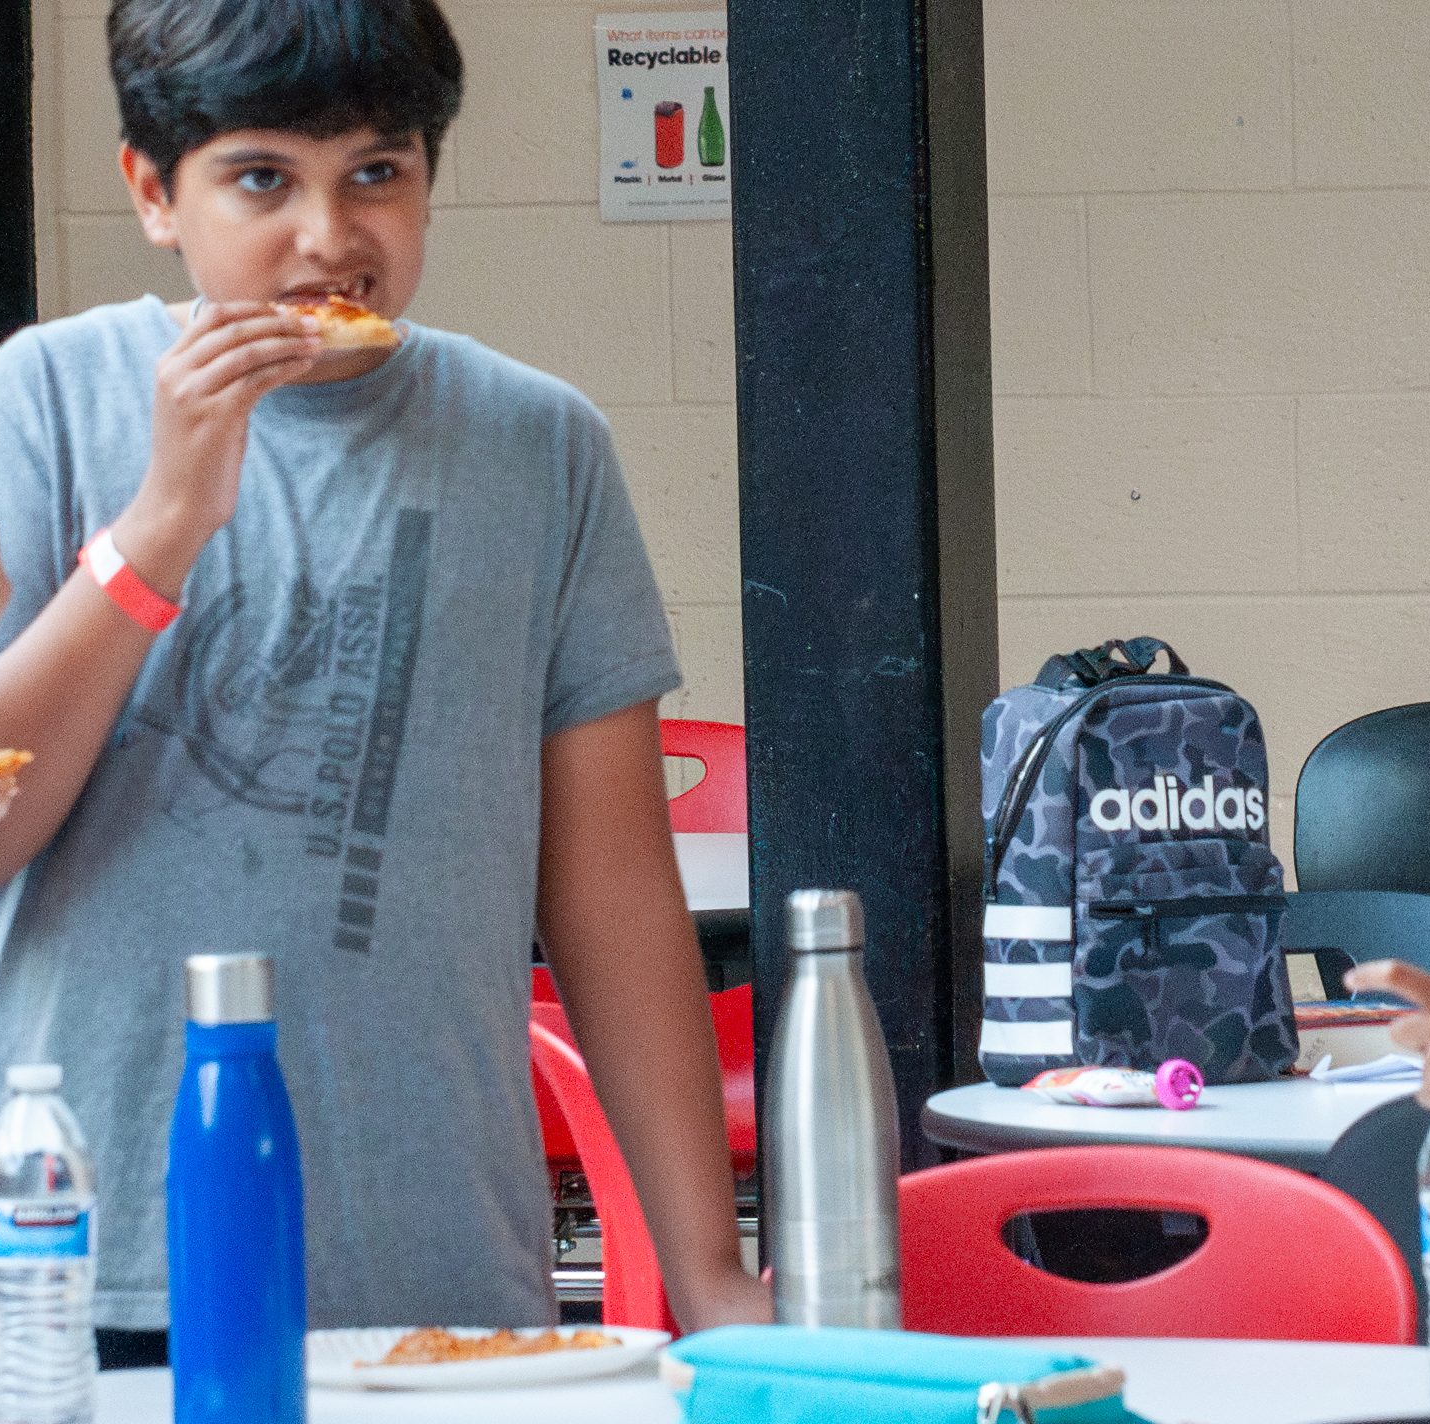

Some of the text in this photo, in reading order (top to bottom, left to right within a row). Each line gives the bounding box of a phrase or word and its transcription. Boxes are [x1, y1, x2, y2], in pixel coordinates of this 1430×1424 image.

[607, 29, 641, 42] What
[645, 29, 681, 41] items
[684, 29, 710, 40] can
[608, 45, 721, 70] Recyclable
[1090, 775, 1265, 832] adidas
